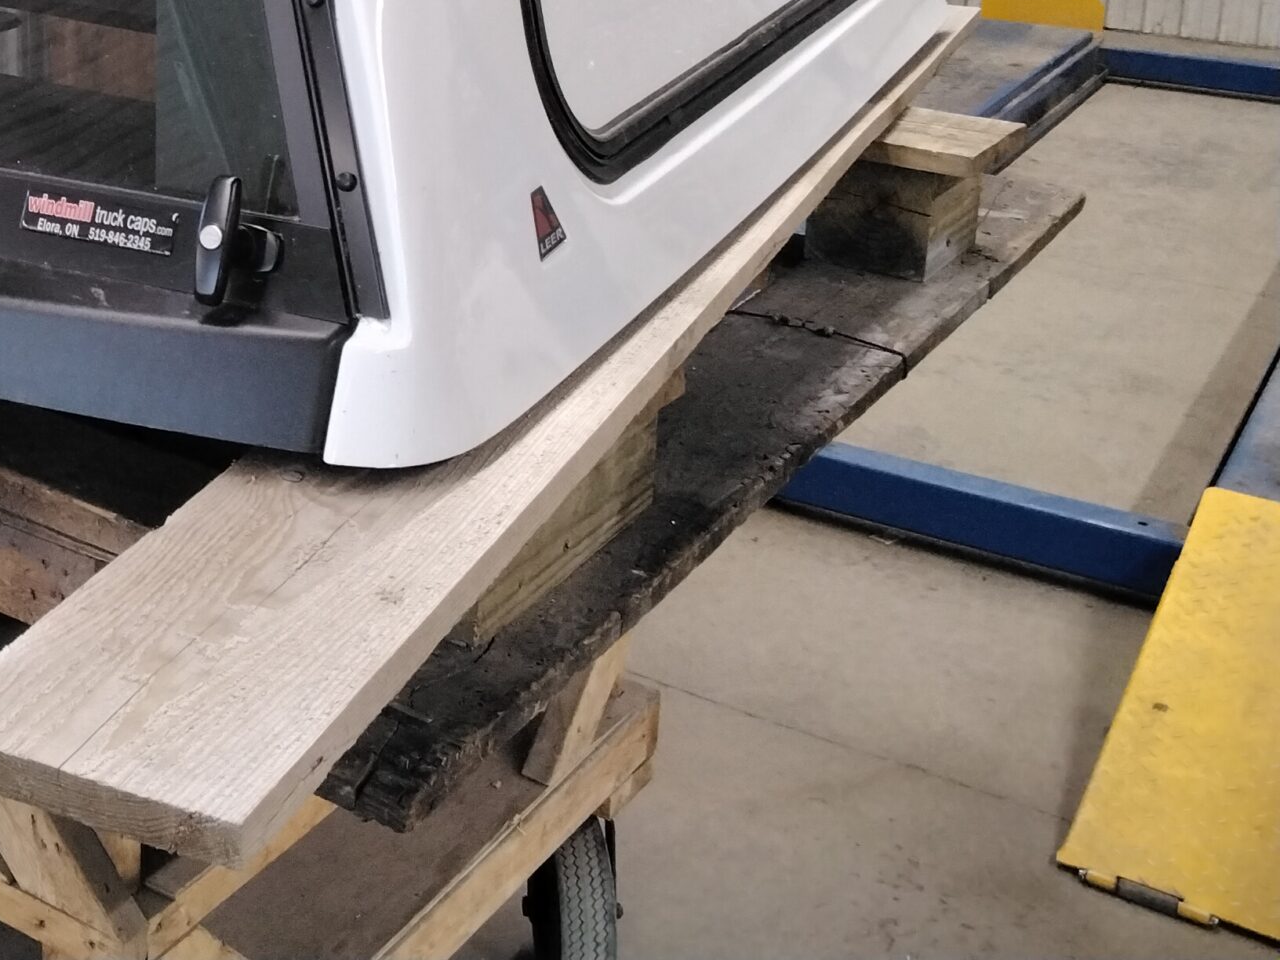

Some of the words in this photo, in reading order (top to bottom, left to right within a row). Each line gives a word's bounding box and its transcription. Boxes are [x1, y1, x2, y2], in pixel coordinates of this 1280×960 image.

[27, 193, 95, 223] windmill
[95, 205, 124, 227] truck
[37, 217, 63, 236] Elora,
[65, 223, 79, 238] ON
[87, 226, 152, 251] 519-846-2345
[540, 227, 565, 254] LEER
